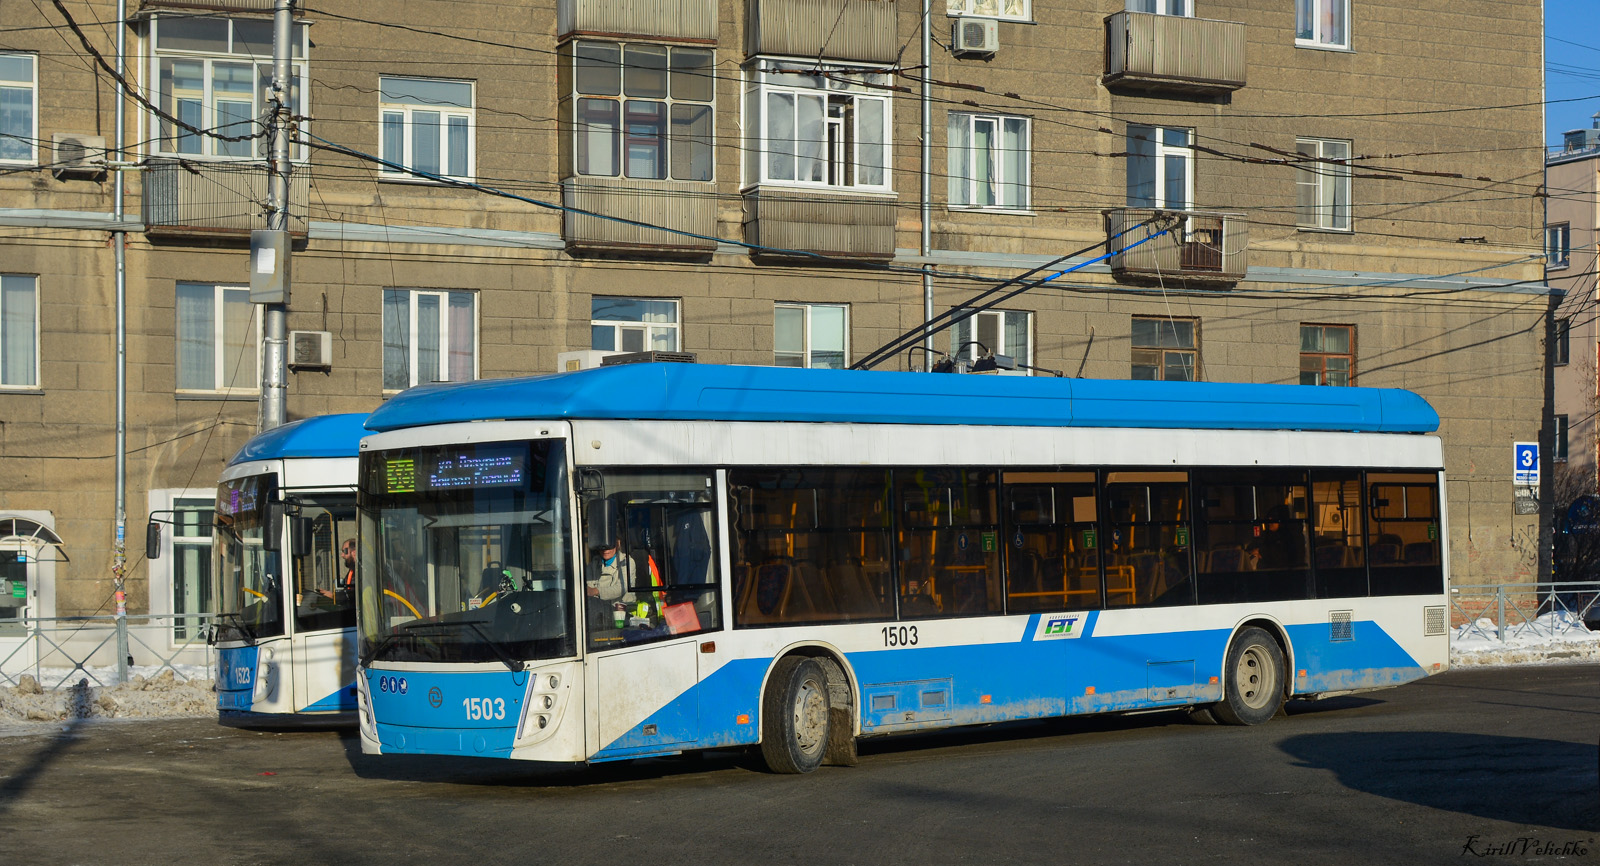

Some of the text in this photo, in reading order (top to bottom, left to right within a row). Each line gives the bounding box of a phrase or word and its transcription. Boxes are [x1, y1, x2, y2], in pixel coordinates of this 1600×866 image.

[1521, 449, 1533, 467] 3
[881, 625, 919, 647] 1503
[235, 667, 251, 684] 1523
[462, 697, 506, 721] 1503
